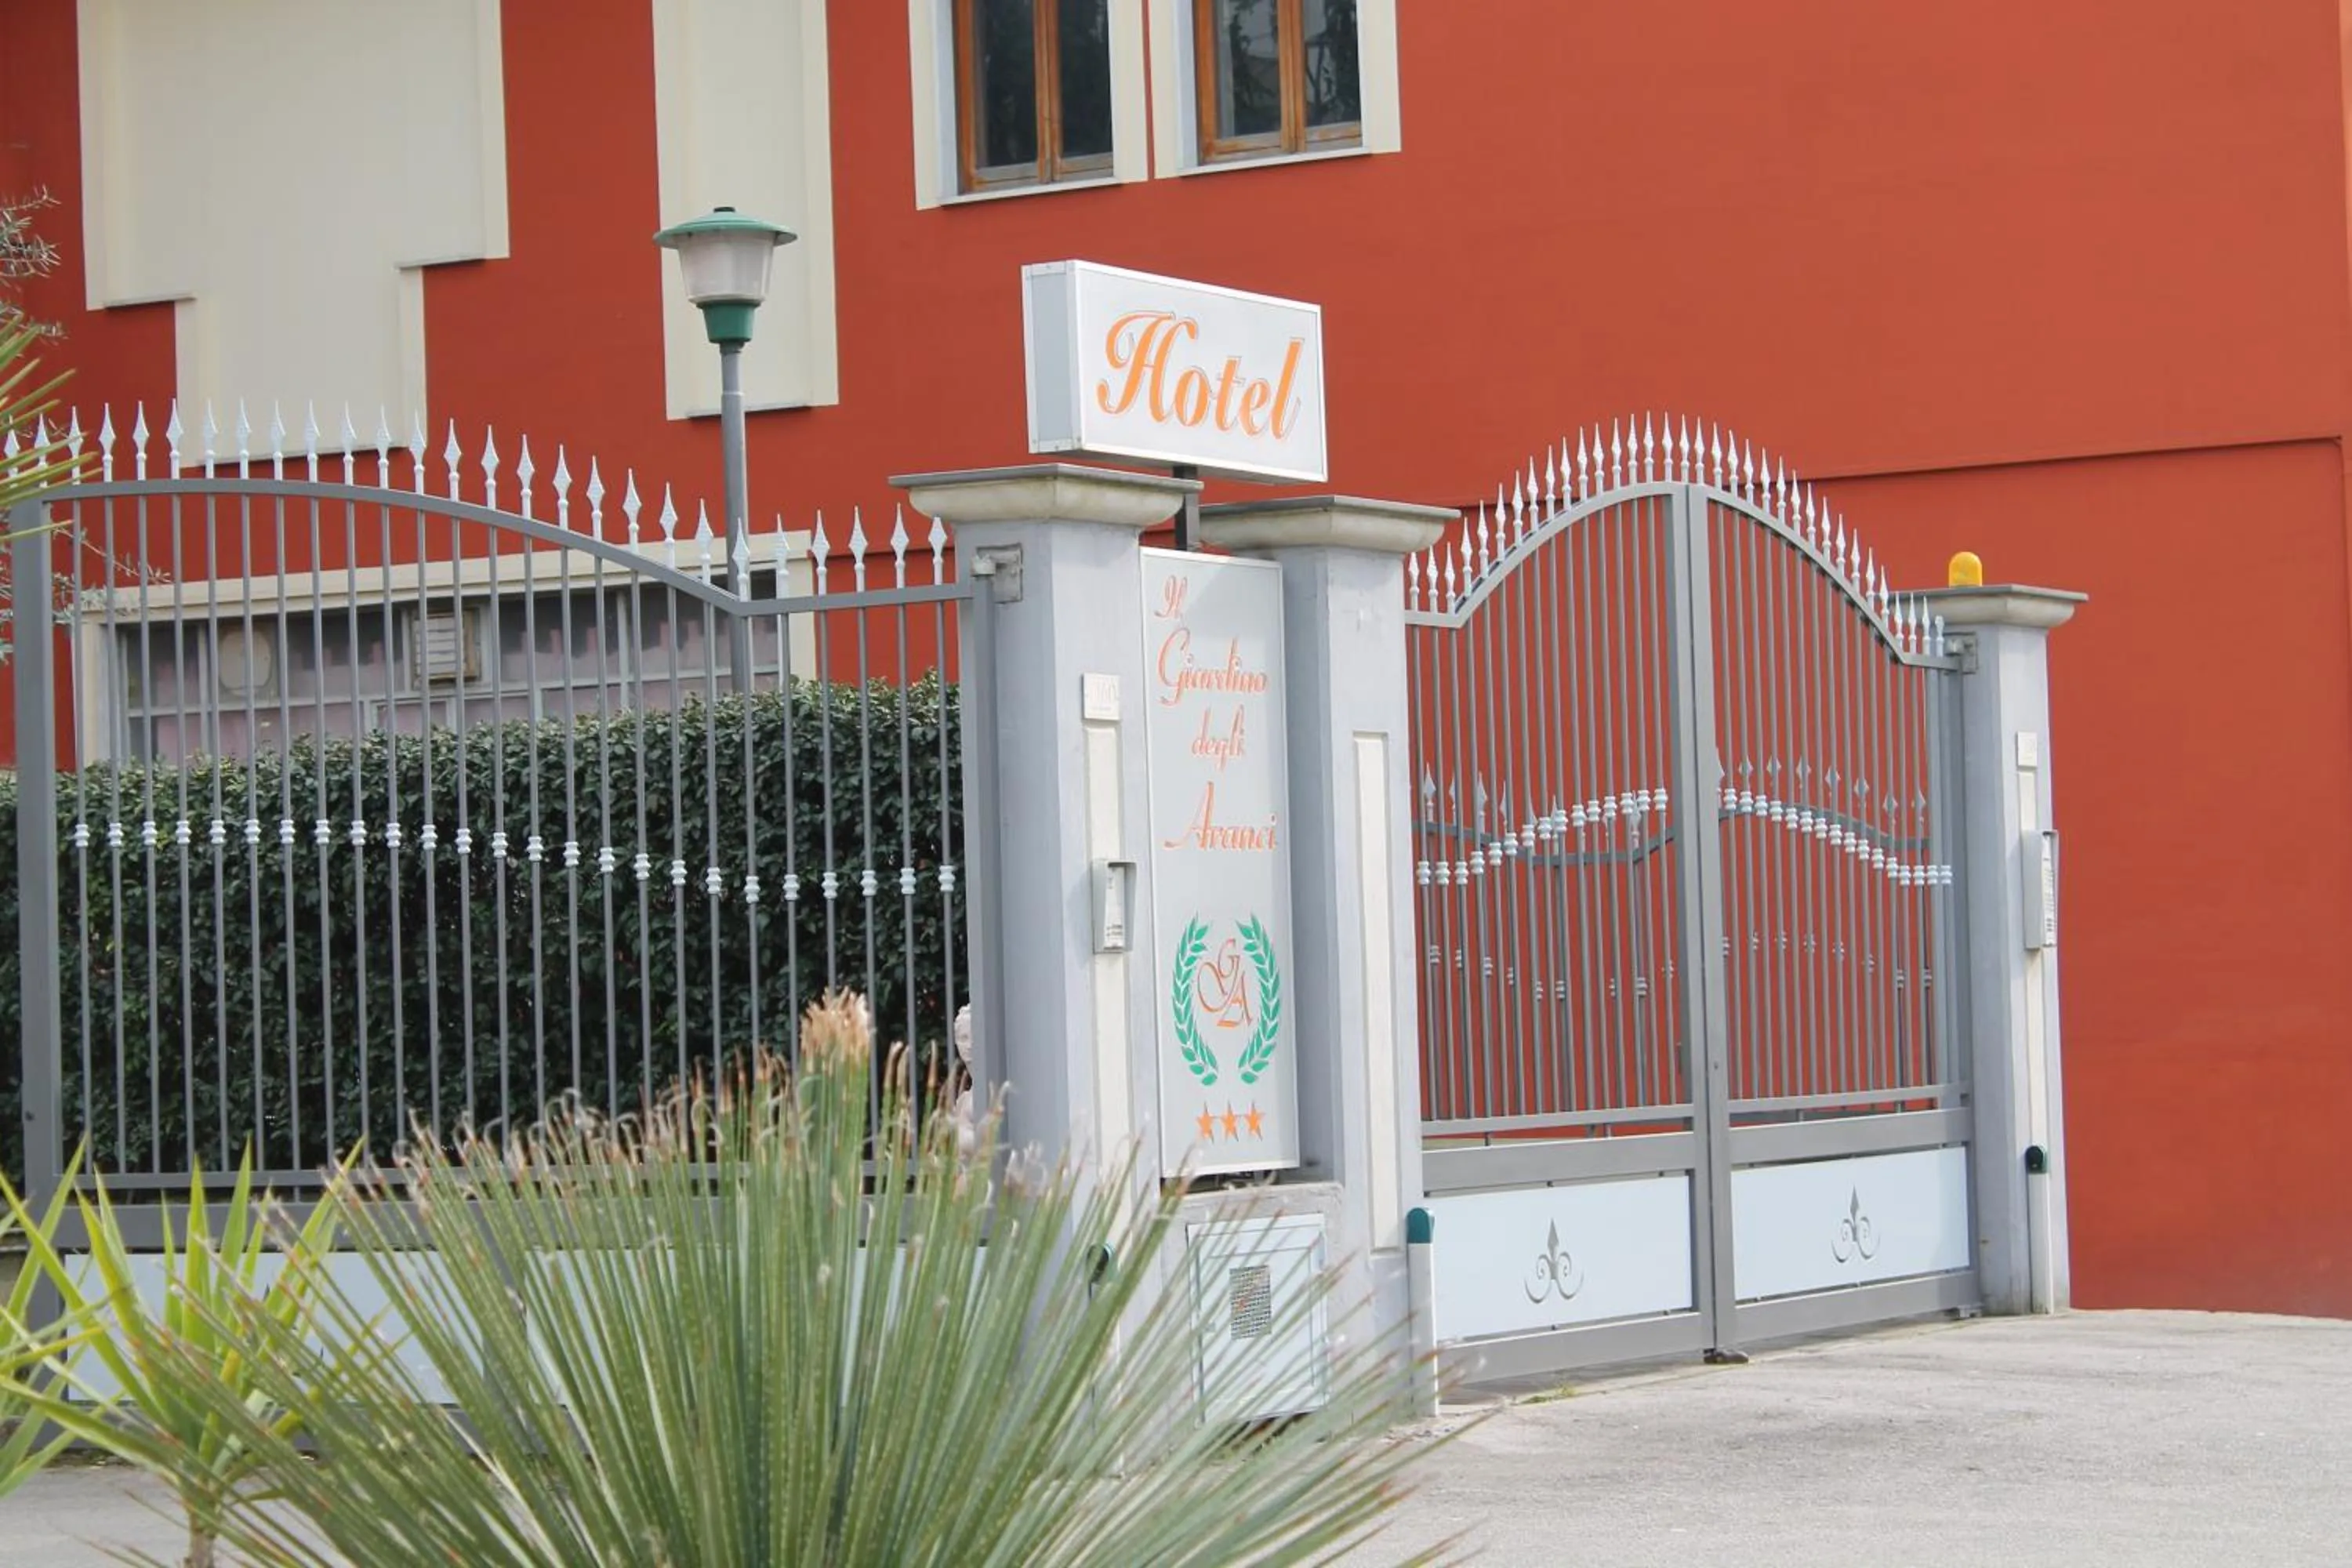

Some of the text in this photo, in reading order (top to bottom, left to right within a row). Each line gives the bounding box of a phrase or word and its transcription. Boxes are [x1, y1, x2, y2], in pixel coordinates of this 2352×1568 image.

[1097, 310, 1305, 441] Hotel
[1157, 628, 1269, 706] Giardino
[1192, 705, 1245, 770] degli
[1164, 780, 1277, 850] Aranci
